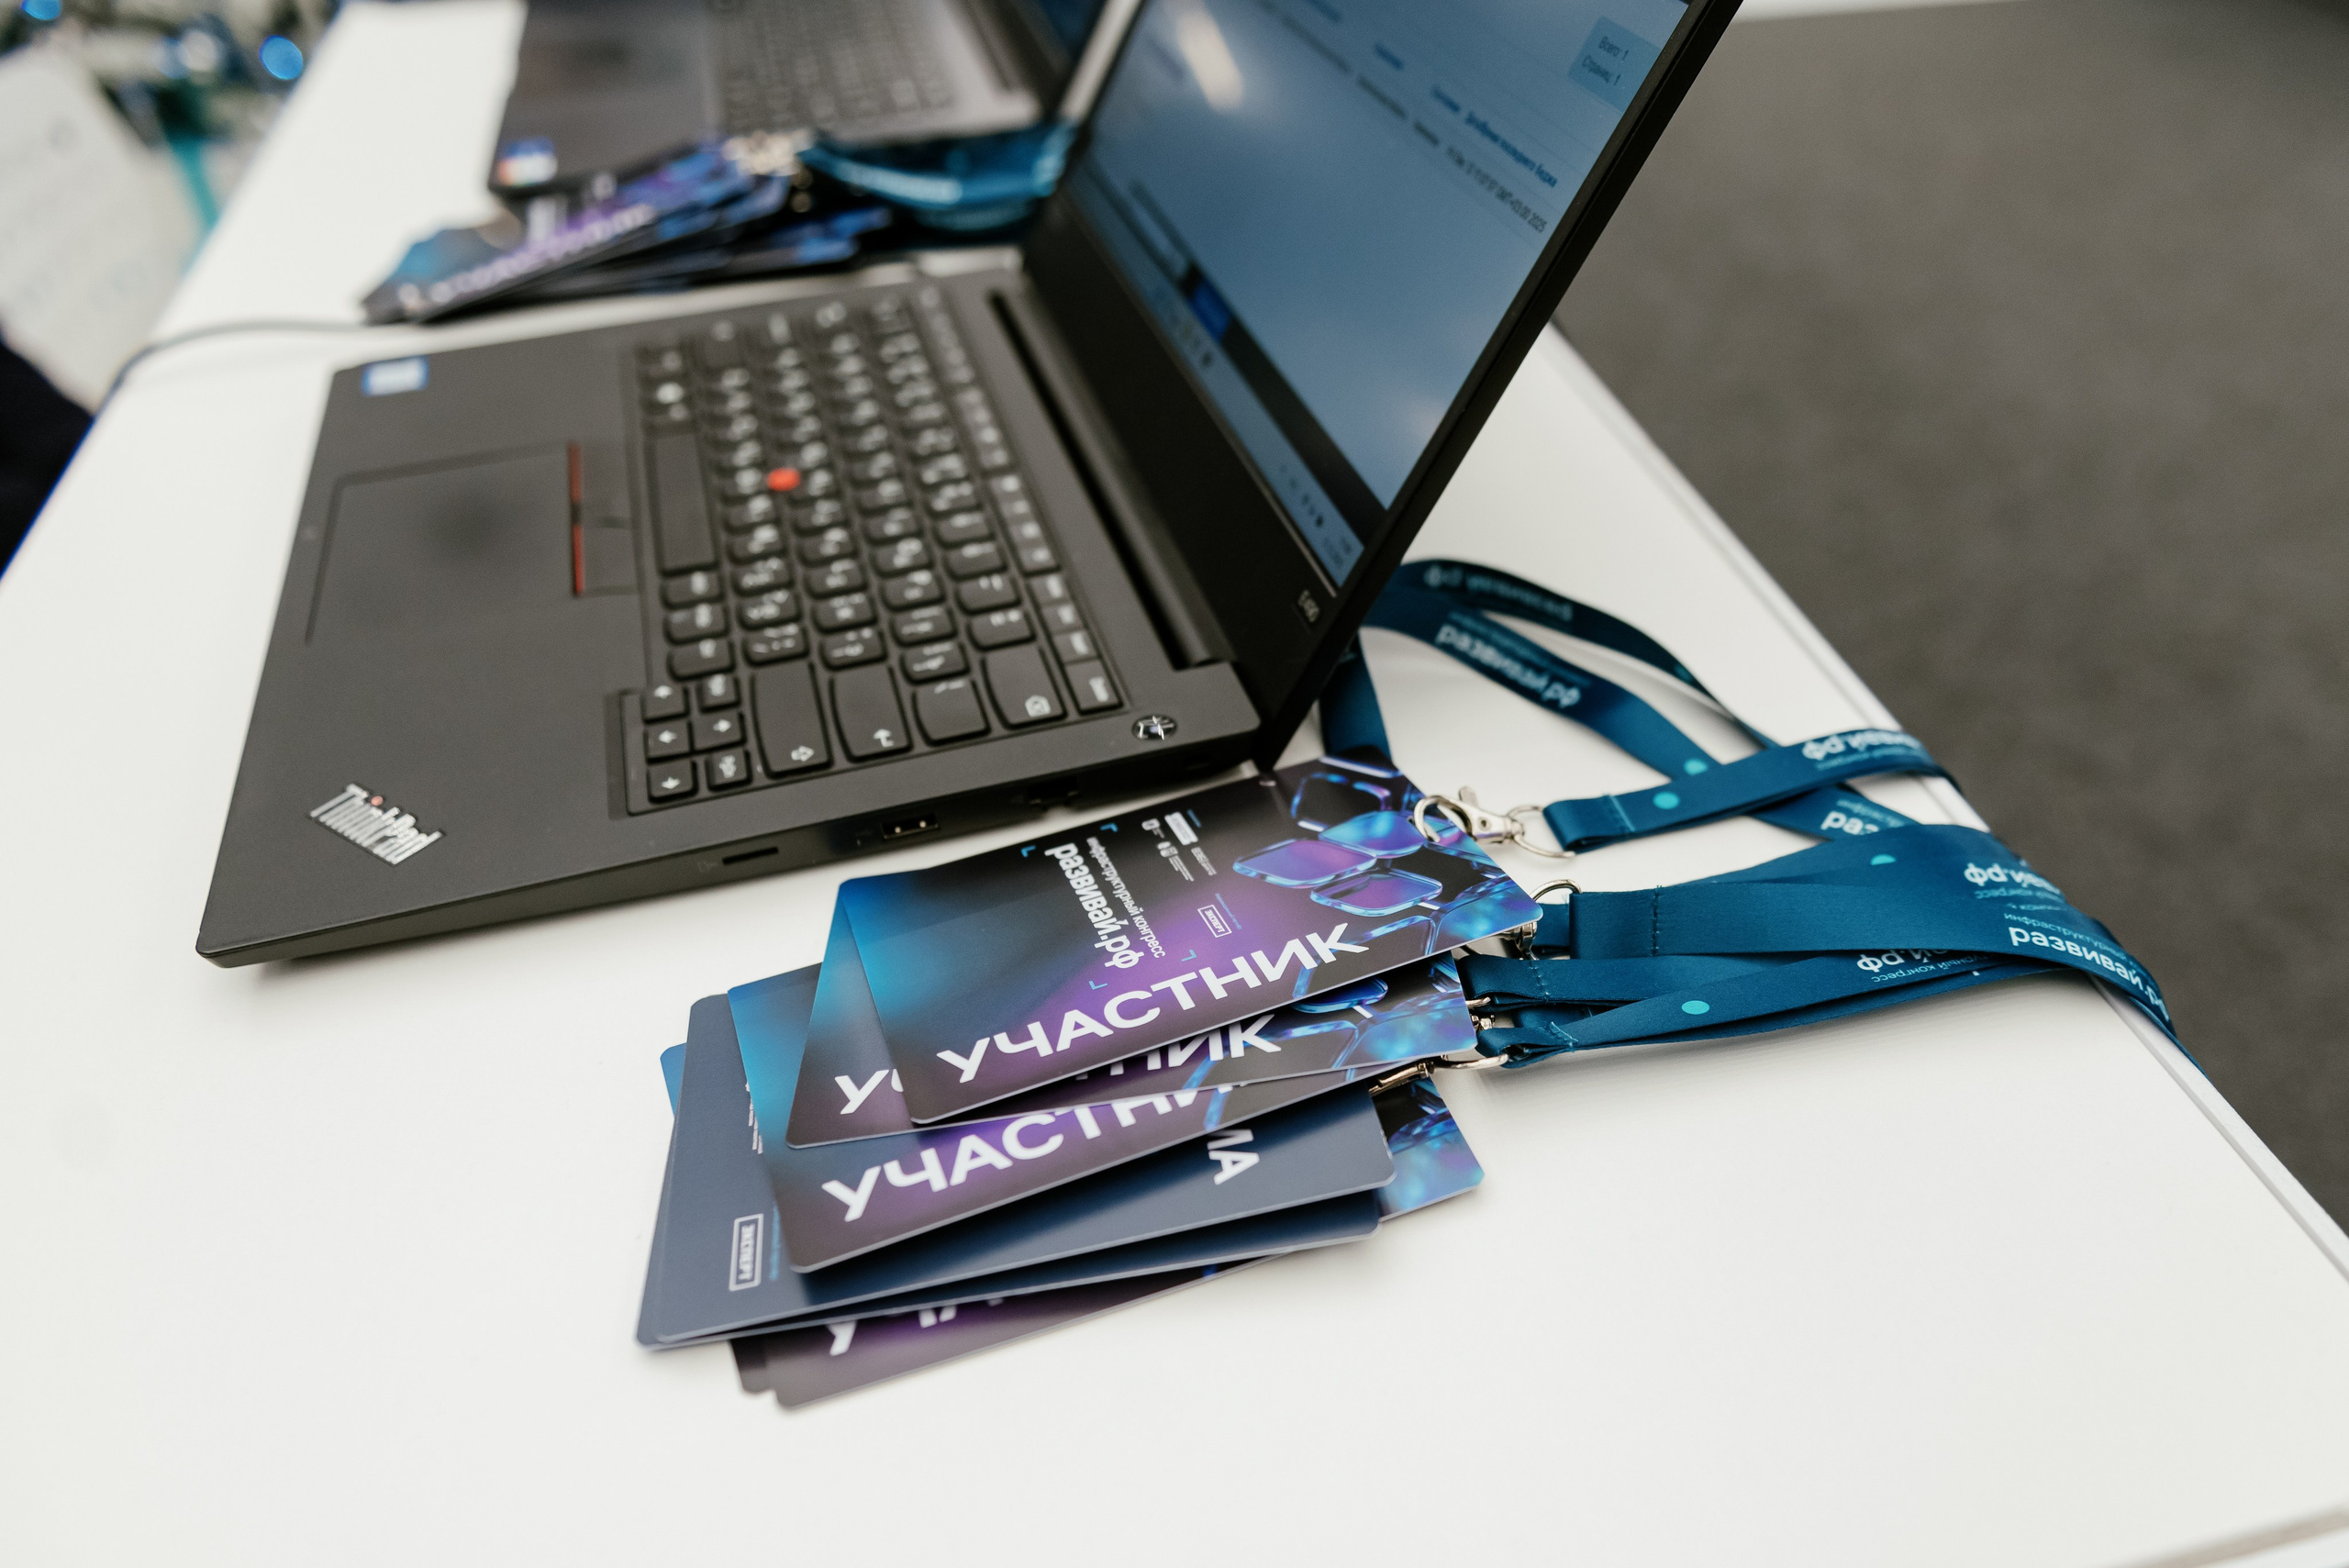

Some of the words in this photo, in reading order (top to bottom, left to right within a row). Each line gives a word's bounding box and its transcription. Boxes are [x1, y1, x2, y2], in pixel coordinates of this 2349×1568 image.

[310, 783, 442, 864] ThinkPad
[1044, 842, 1145, 970] развивай.рф
[1086, 837, 1145, 917] инфраструктурный
[1131, 911, 1166, 959] конгресс
[1203, 908, 1227, 934] ЭКСПЕРТ
[937, 923, 1369, 1084] УЧАСТНИК
[1871, 963, 1935, 983] конгресс
